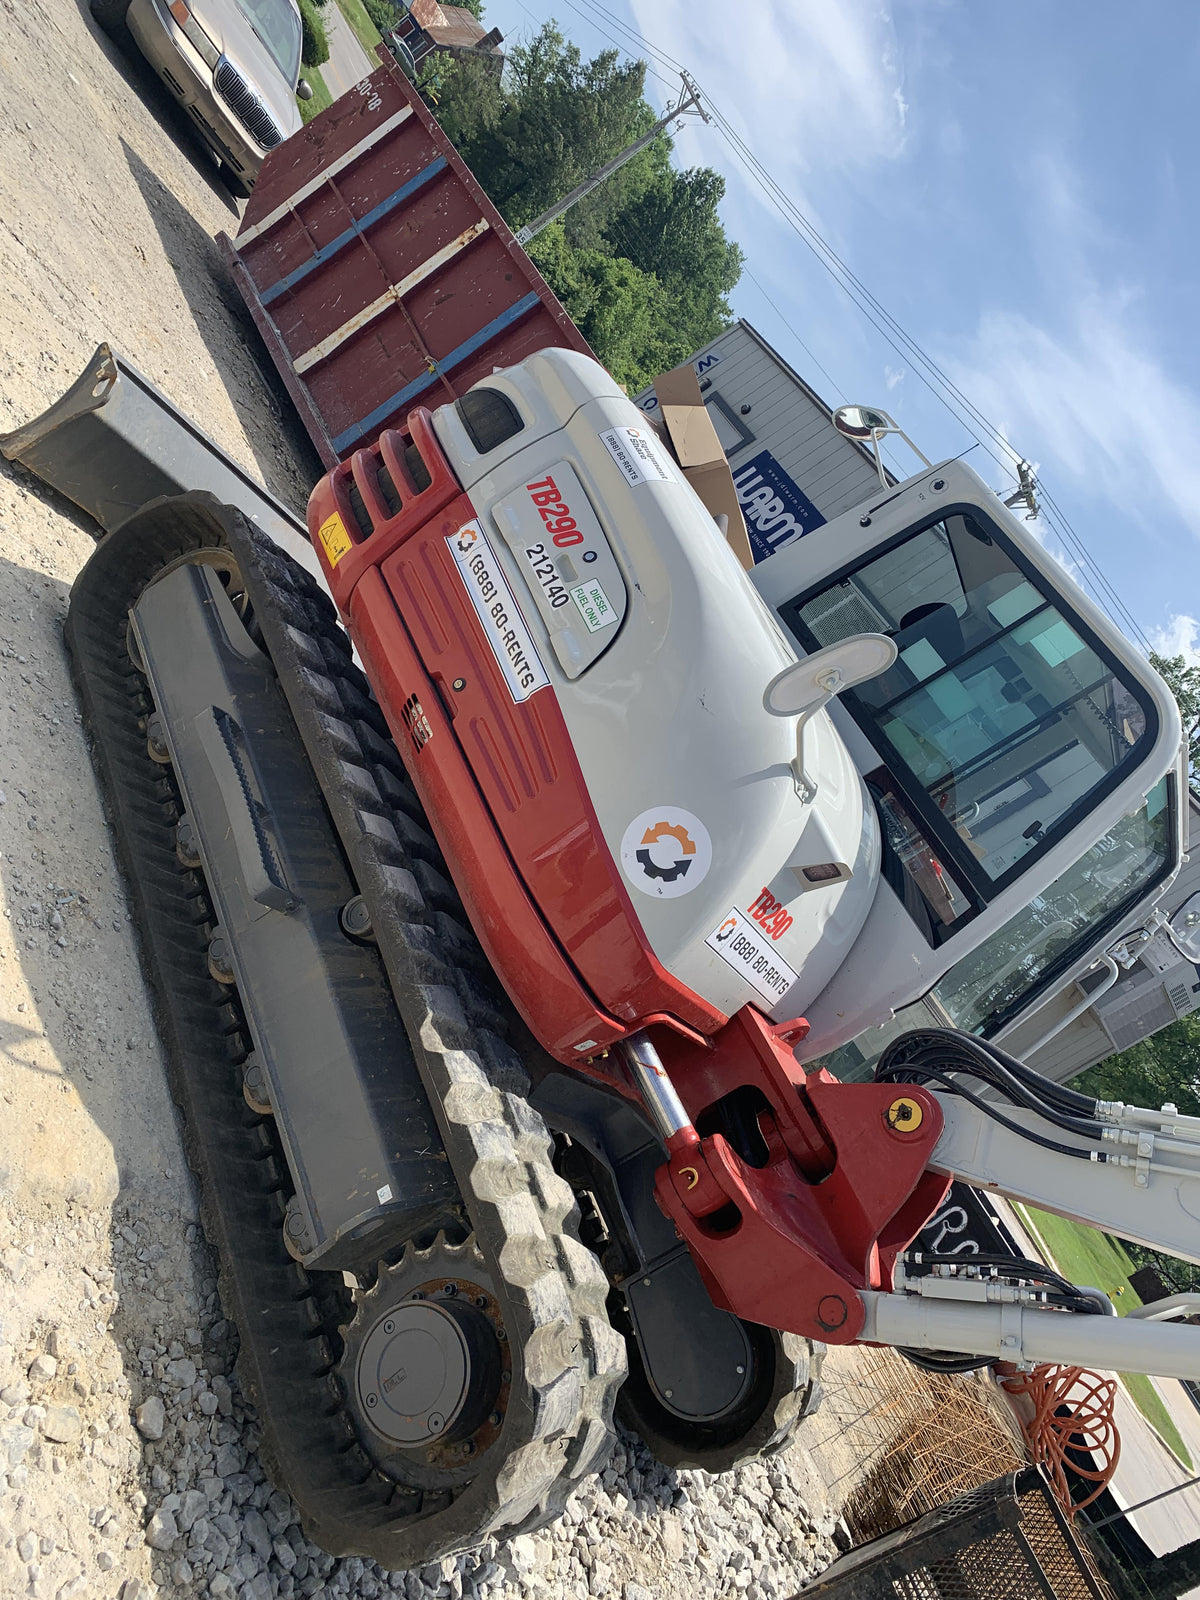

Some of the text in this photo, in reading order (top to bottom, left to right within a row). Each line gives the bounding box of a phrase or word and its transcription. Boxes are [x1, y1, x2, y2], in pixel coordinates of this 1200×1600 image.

[516, 232, 526, 244] 35
[606, 435, 621, 452] (888)
[630, 438, 647, 460] Share
[638, 438, 668, 480] Equipment
[526, 475, 584, 548] TB290
[733, 466, 803, 553] WARM
[526, 543, 570, 609] 212140
[469, 553, 535, 689] (888) 80-RENTS
[574, 587, 602, 628] FUEL ONLY
[589, 588, 609, 616] DIESEL
[747, 886, 794, 941] TB290
[729, 932, 760, 965] (888)
